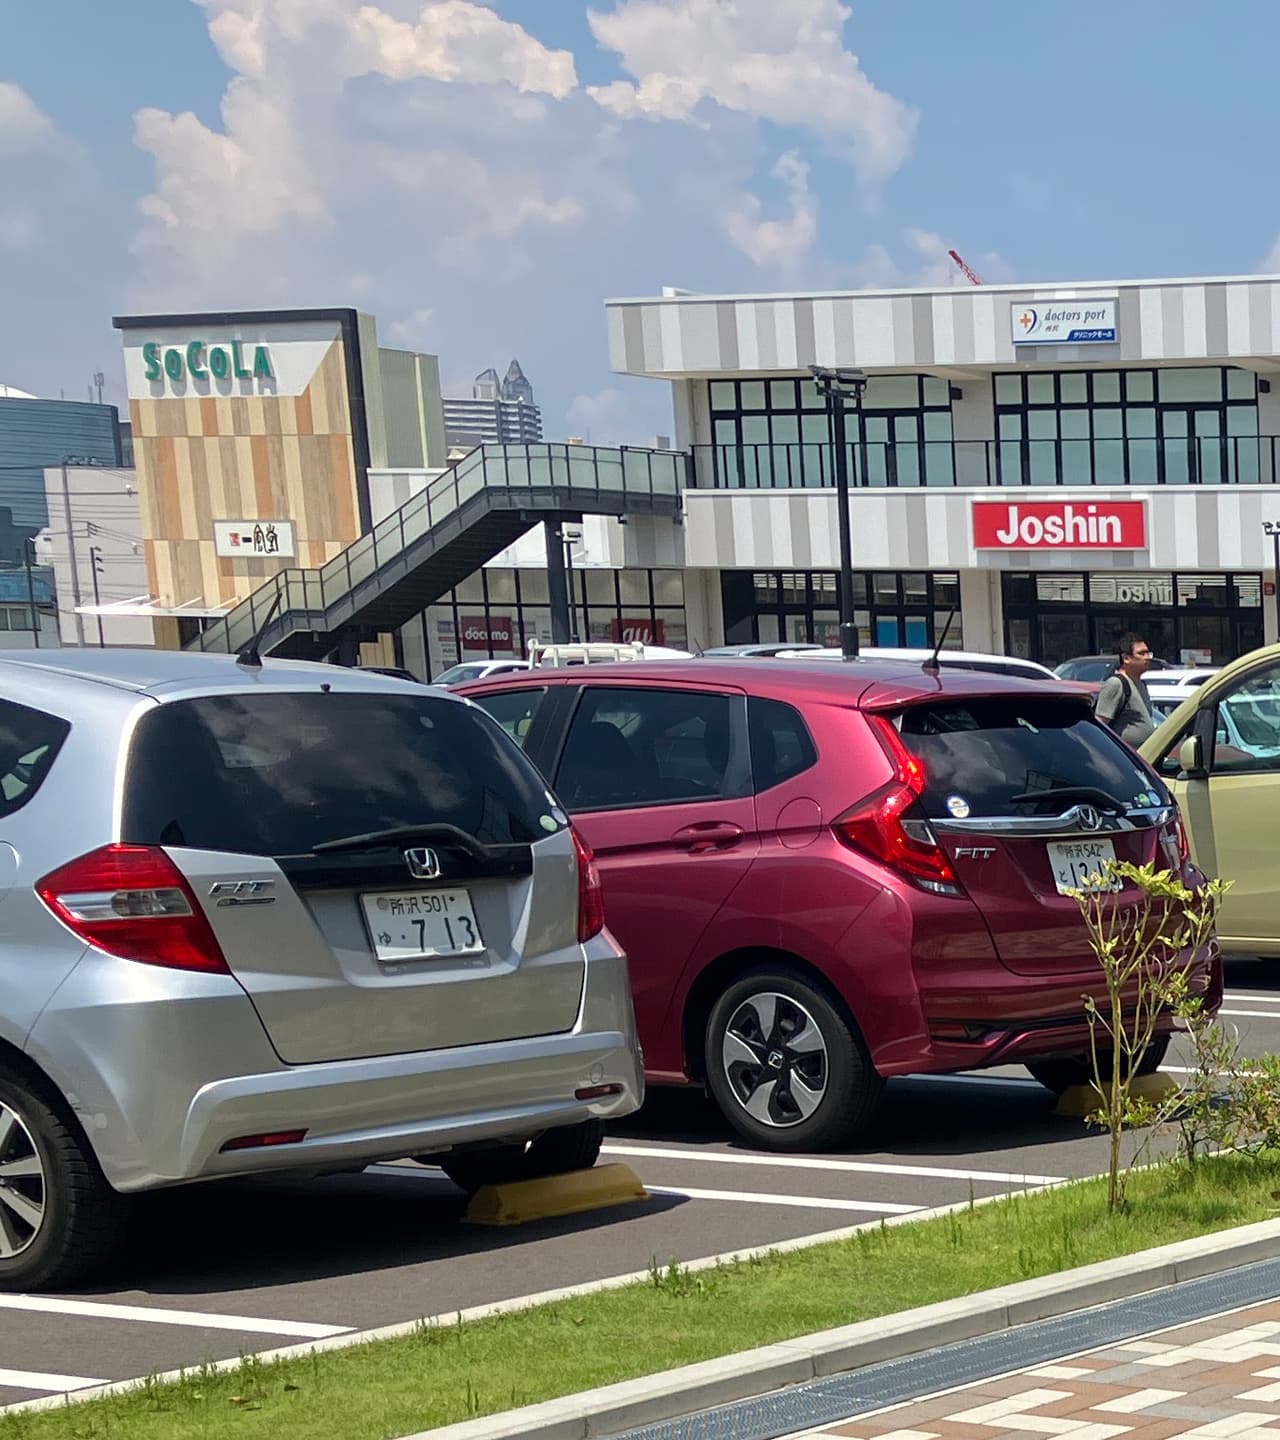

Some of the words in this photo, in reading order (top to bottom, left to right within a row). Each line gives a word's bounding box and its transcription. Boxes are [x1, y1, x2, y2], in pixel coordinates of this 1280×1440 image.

[1044, 307, 1081, 321] doctors
[1084, 309, 1106, 324] port
[996, 505, 1122, 545] Joshin
[464, 627, 509, 641] docmo
[954, 847, 996, 860] FIT
[207, 879, 275, 896] FIT
